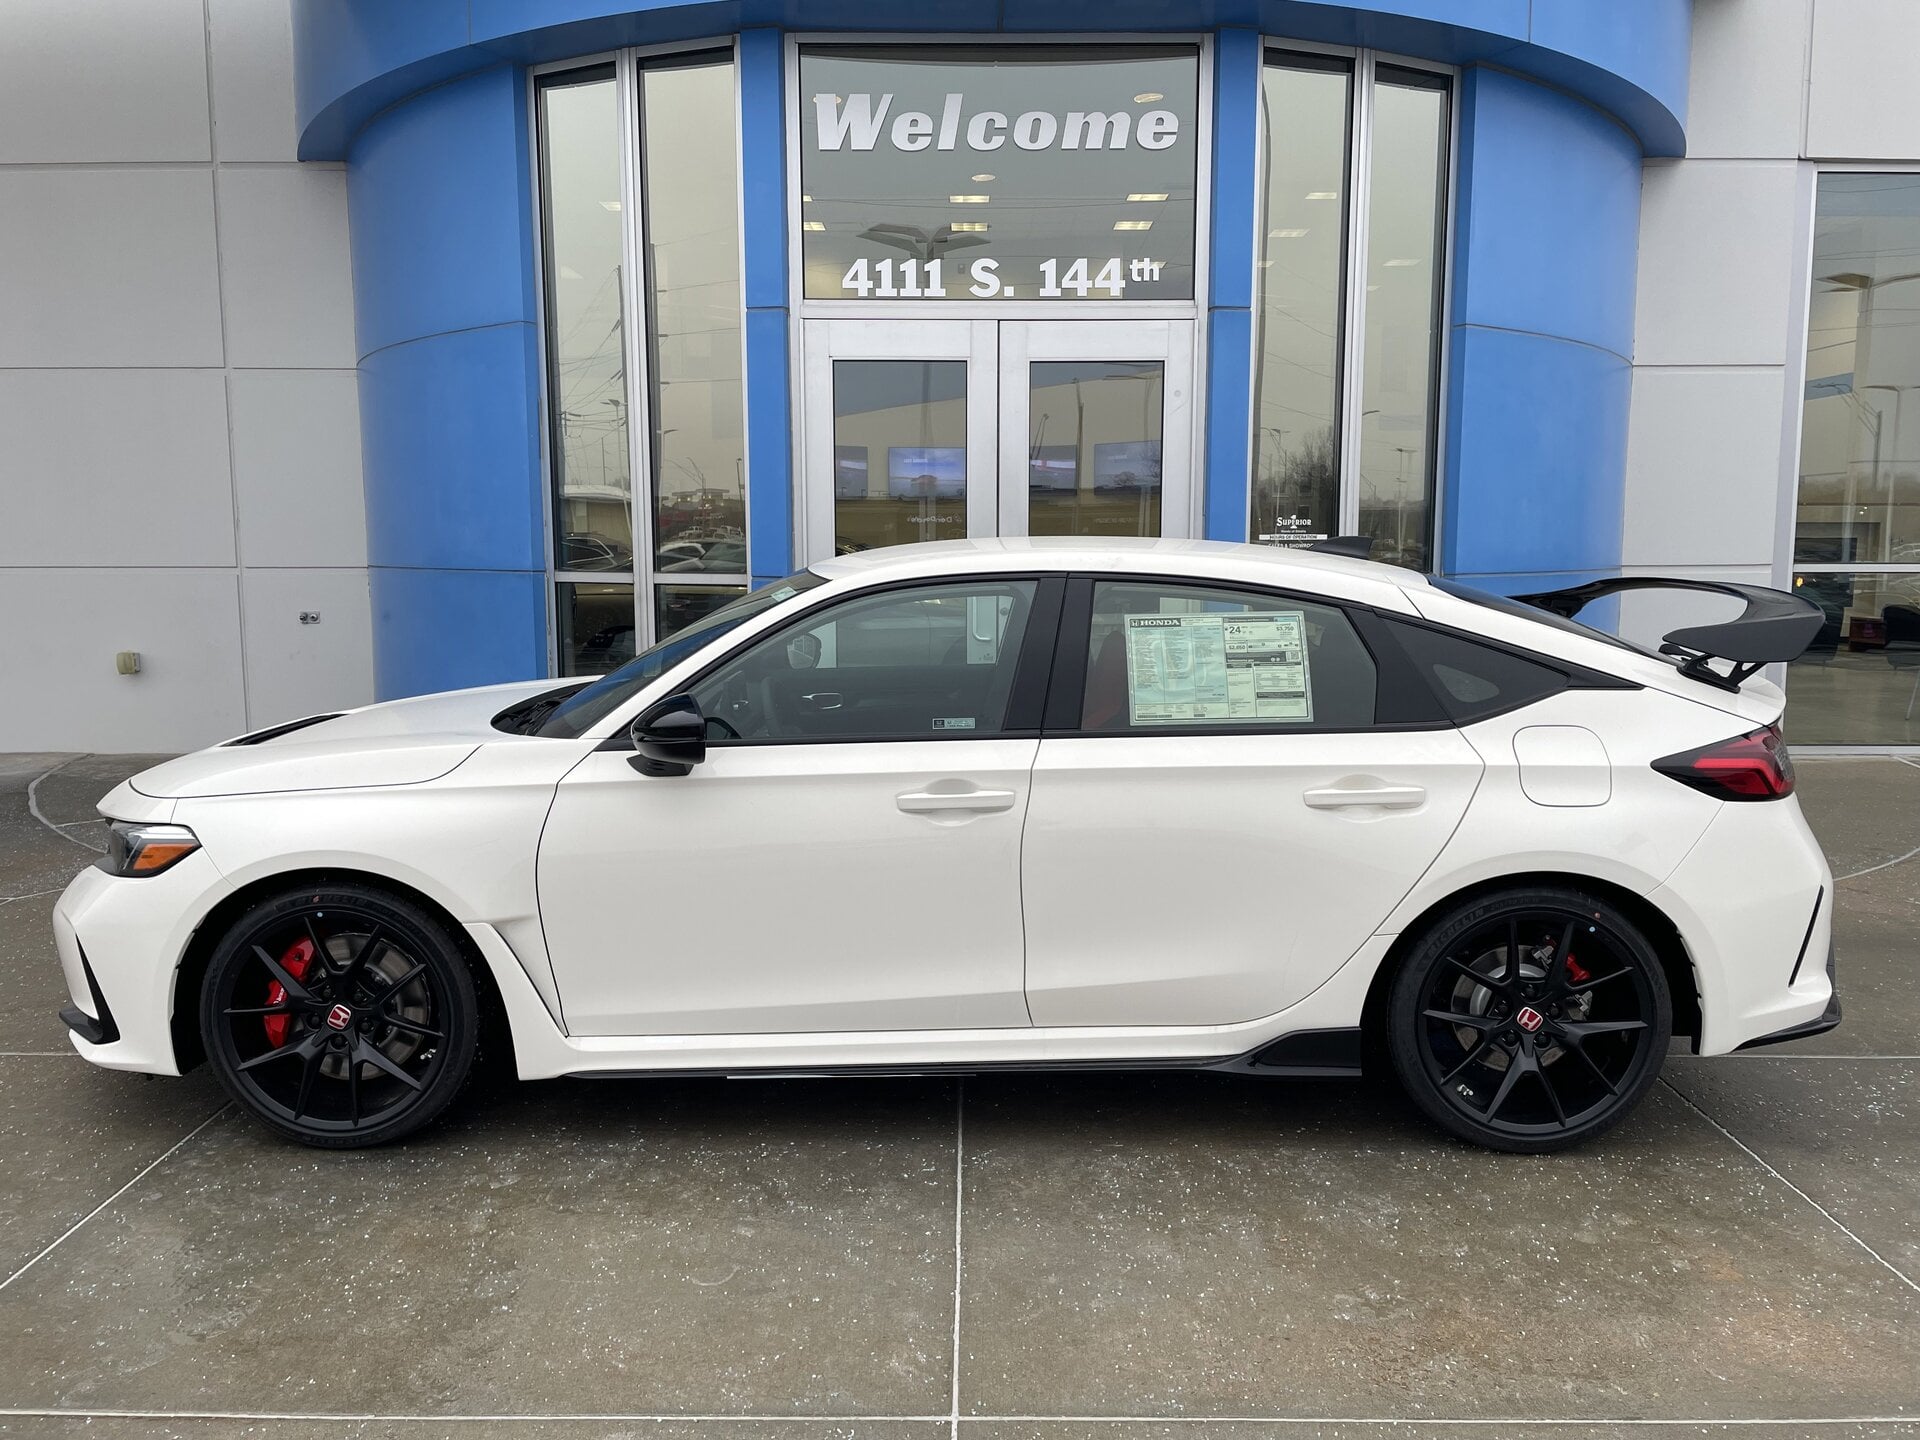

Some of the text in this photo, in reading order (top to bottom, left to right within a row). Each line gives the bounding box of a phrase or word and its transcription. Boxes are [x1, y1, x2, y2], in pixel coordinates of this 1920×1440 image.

[814, 92, 1180, 152] Welcome
[841, 257, 1160, 298] 4111 S. 144th
[1140, 619, 1180, 627] HONDA
[1229, 626, 1242, 634] 24
